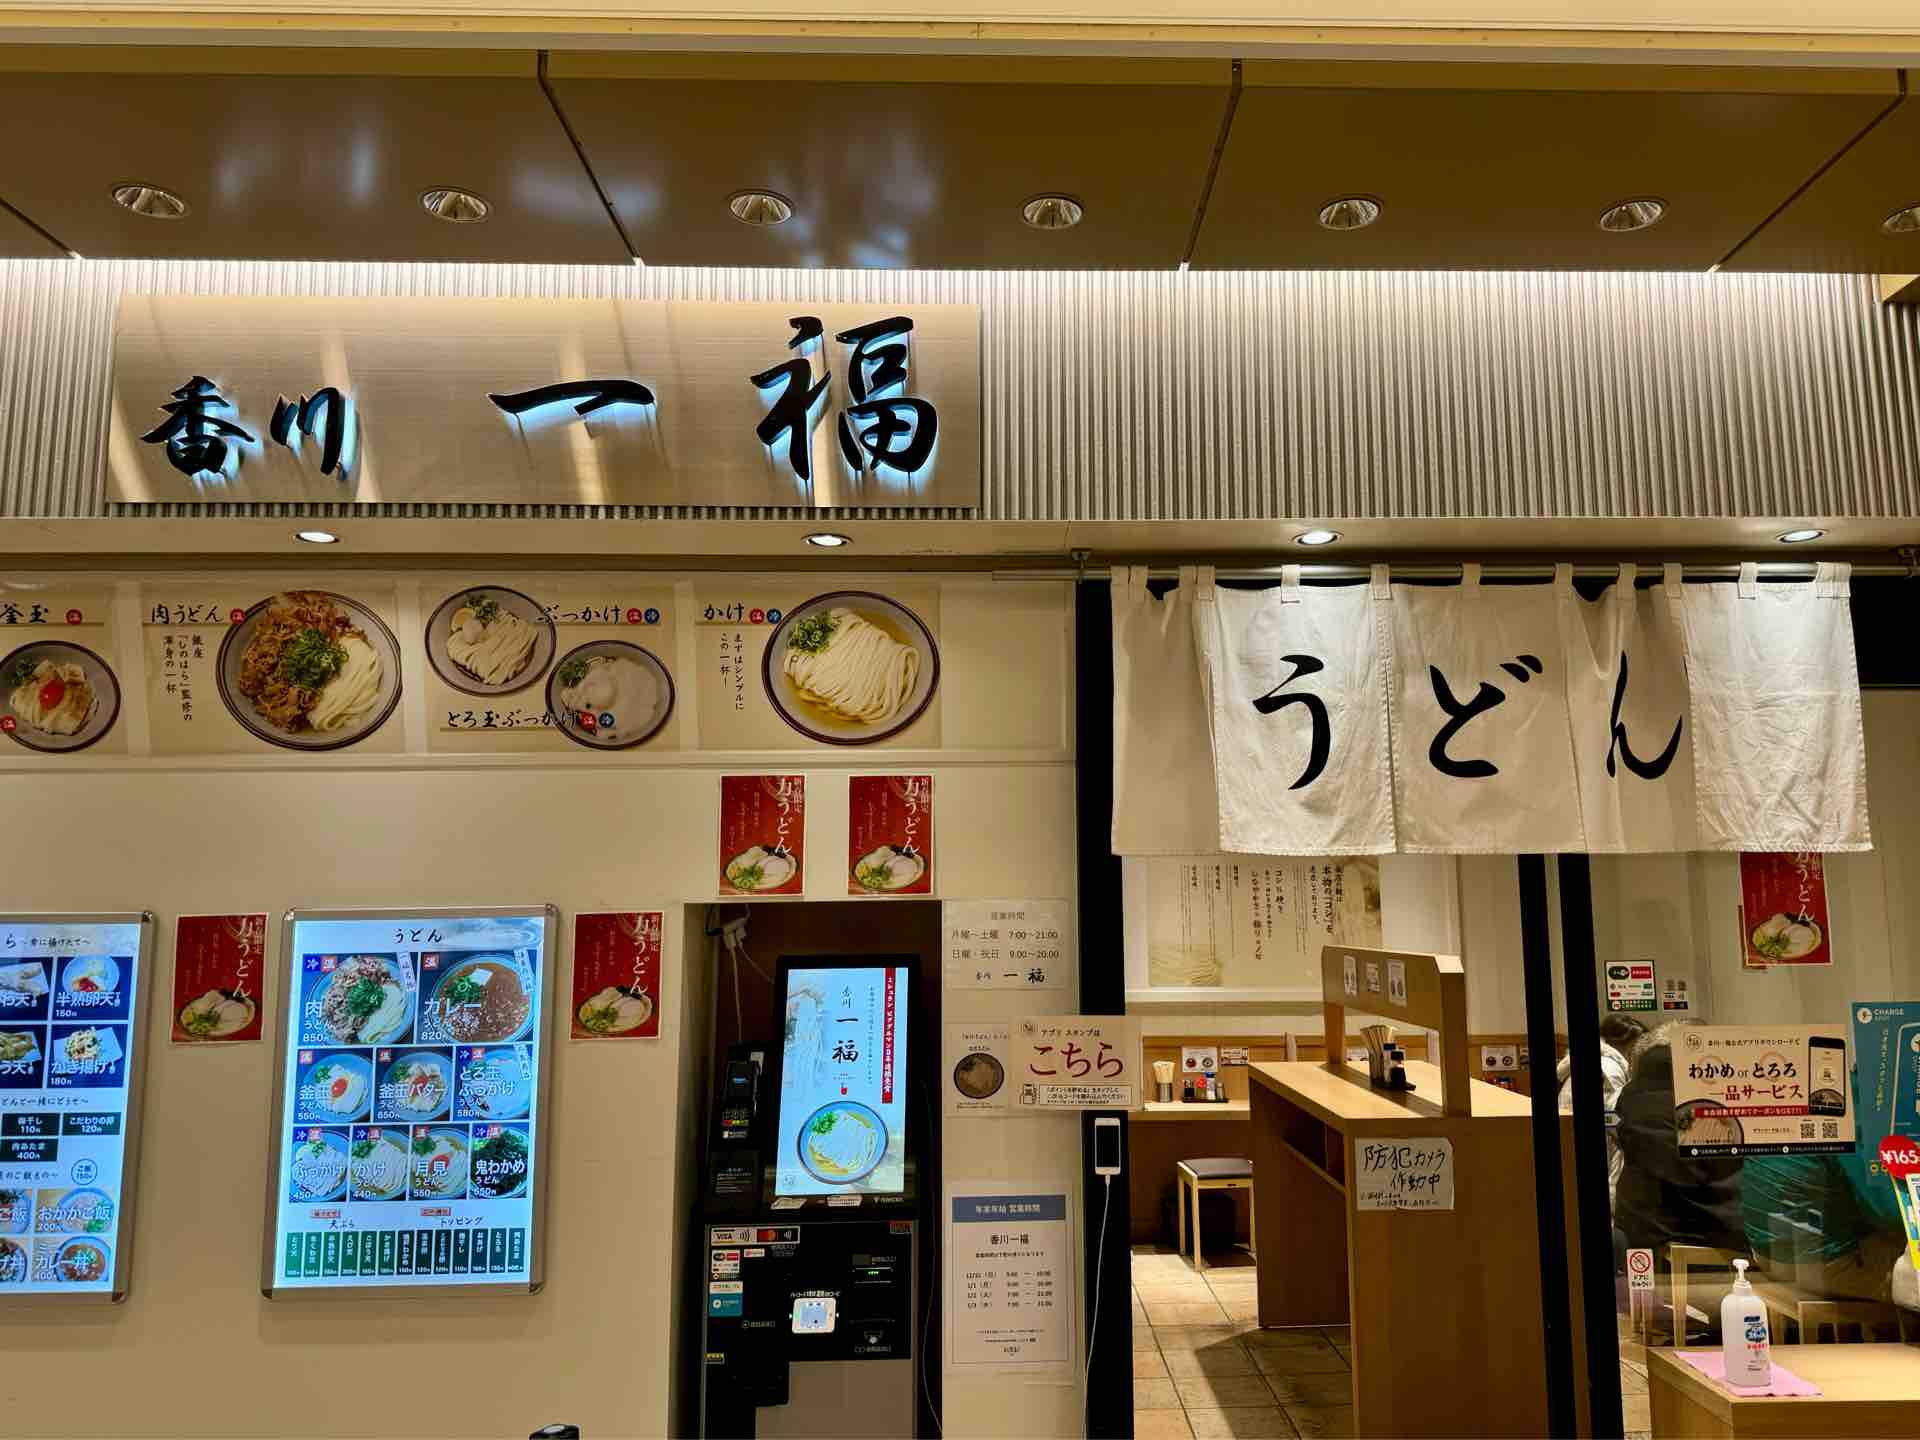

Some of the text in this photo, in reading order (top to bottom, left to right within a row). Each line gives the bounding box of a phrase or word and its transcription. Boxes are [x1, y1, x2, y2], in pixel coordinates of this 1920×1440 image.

[140, 316, 939, 480] 香川 一福
[0, 603, 49, 625] 釜玉
[151, 603, 225, 625] 肉うどん
[537, 604, 622, 624] ぶっかけ
[704, 602, 745, 622] かけ
[447, 709, 580, 728] とろ玉ぶっかけ
[1253, 650, 1682, 790] うどん
[776, 778, 793, 854] 力うどん
[903, 778, 921, 854] 力うどん
[630, 914, 651, 995] 力うどん
[306, 1001, 323, 1017] 肉
[832, 1017, 859, 1064] 一福
[1030, 1041, 1124, 1079] こちら
[1689, 1063, 1735, 1080] わかめ
[1752, 1062, 1797, 1079] とろろ
[1709, 1084, 1804, 1102] 一品サービス
[476, 1159, 525, 1175] 鬼わかめ
